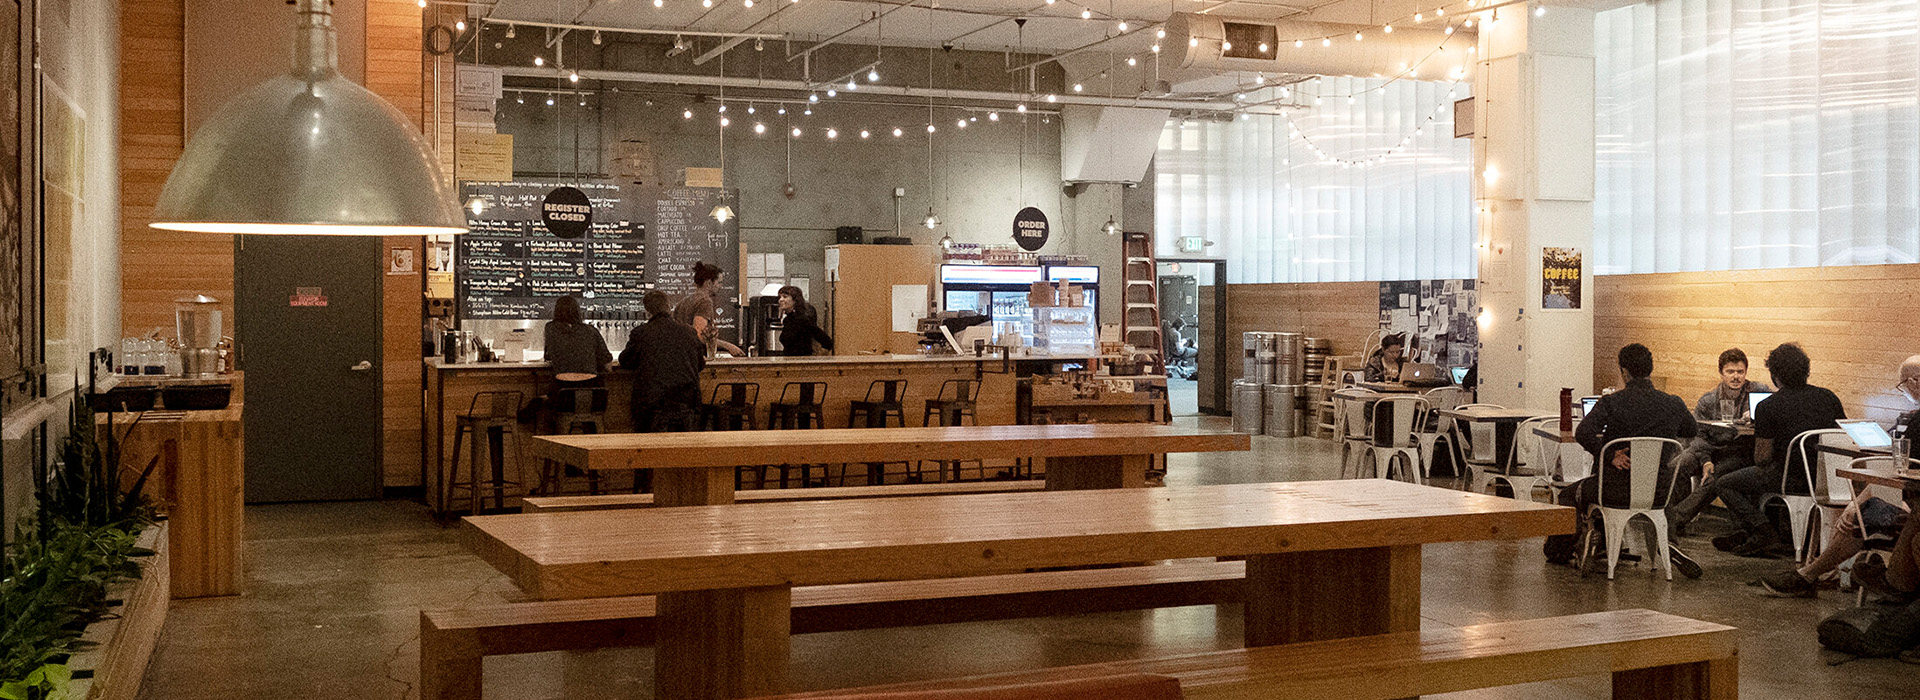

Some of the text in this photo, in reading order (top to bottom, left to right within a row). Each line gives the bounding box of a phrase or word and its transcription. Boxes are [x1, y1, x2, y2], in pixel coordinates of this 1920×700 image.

[544, 203, 590, 213] REGISTER
[549, 213, 586, 221] CLOSED
[1018, 220, 1045, 229] ORDER
[1186, 237, 1202, 250] EXIT
[1544, 268, 1579, 279] COFFEE
